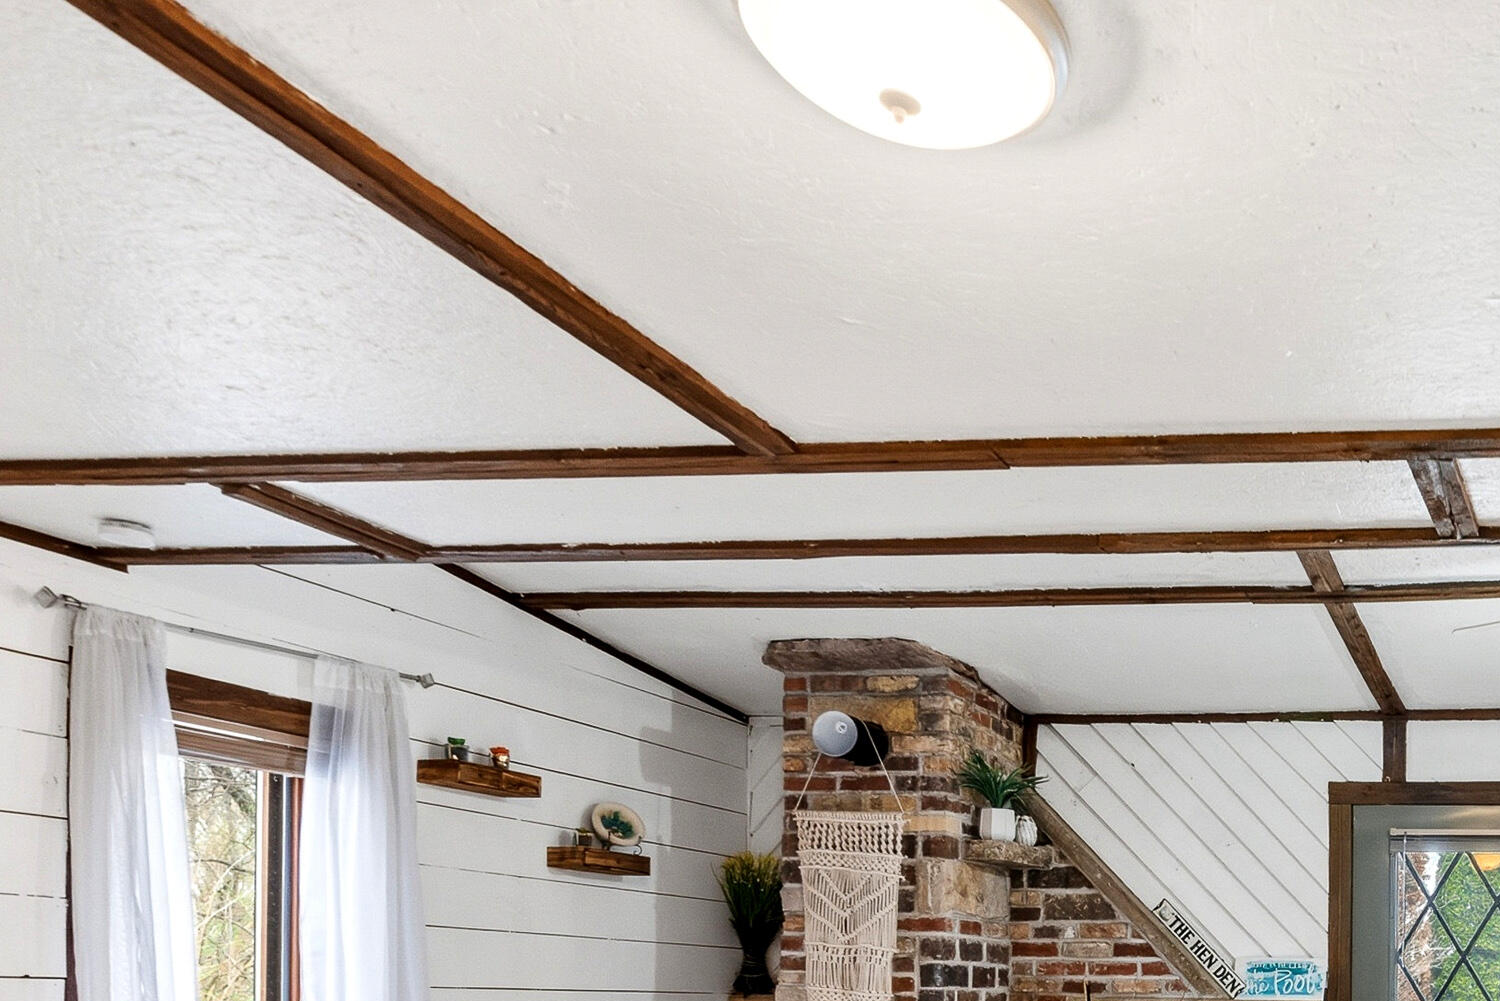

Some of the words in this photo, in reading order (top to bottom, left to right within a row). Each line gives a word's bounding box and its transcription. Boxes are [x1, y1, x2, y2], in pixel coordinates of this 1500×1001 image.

[1168, 914, 1196, 945] THE
[1190, 940, 1217, 968] HEN
[1213, 964, 1241, 994] DEN
[1274, 966, 1316, 998] Pool
